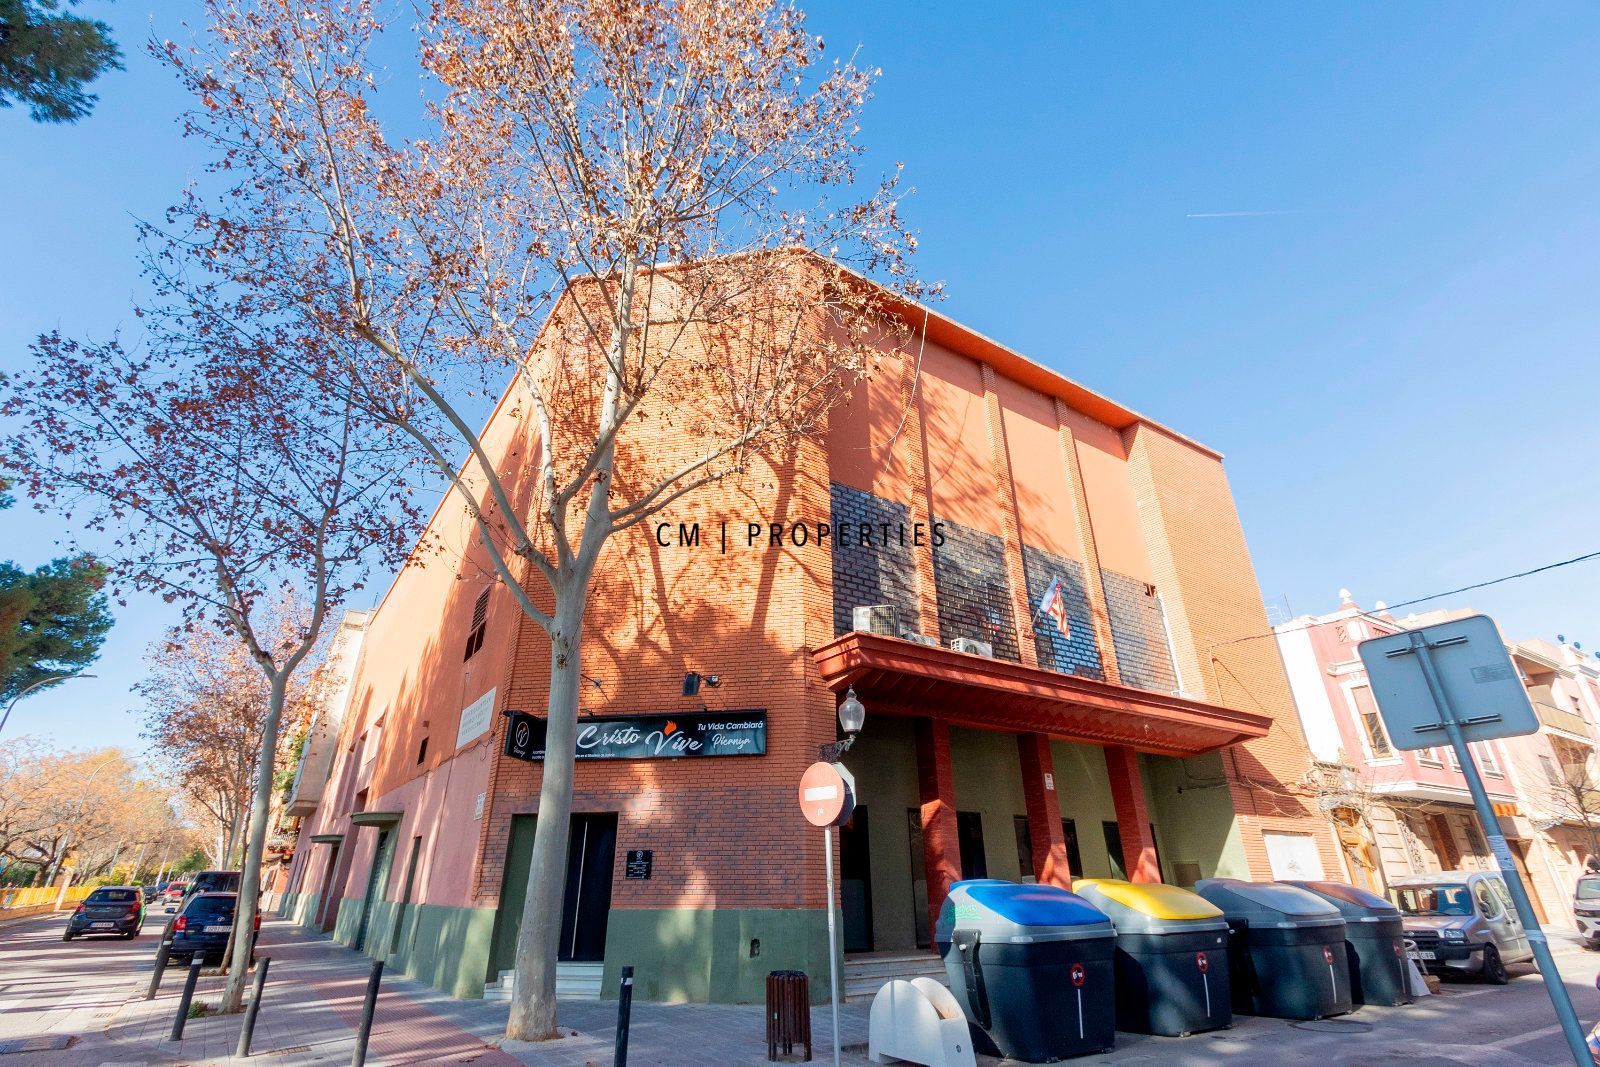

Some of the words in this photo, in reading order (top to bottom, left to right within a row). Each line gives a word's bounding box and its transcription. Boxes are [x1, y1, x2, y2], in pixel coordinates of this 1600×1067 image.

[697, 723, 706, 731] Tu
[707, 722, 725, 731] Vida
[726, 720, 764, 730] Cambiará
[576, 725, 640, 749] Cristo
[645, 730, 703, 755] Vive
[711, 732, 751, 750] Picanya
